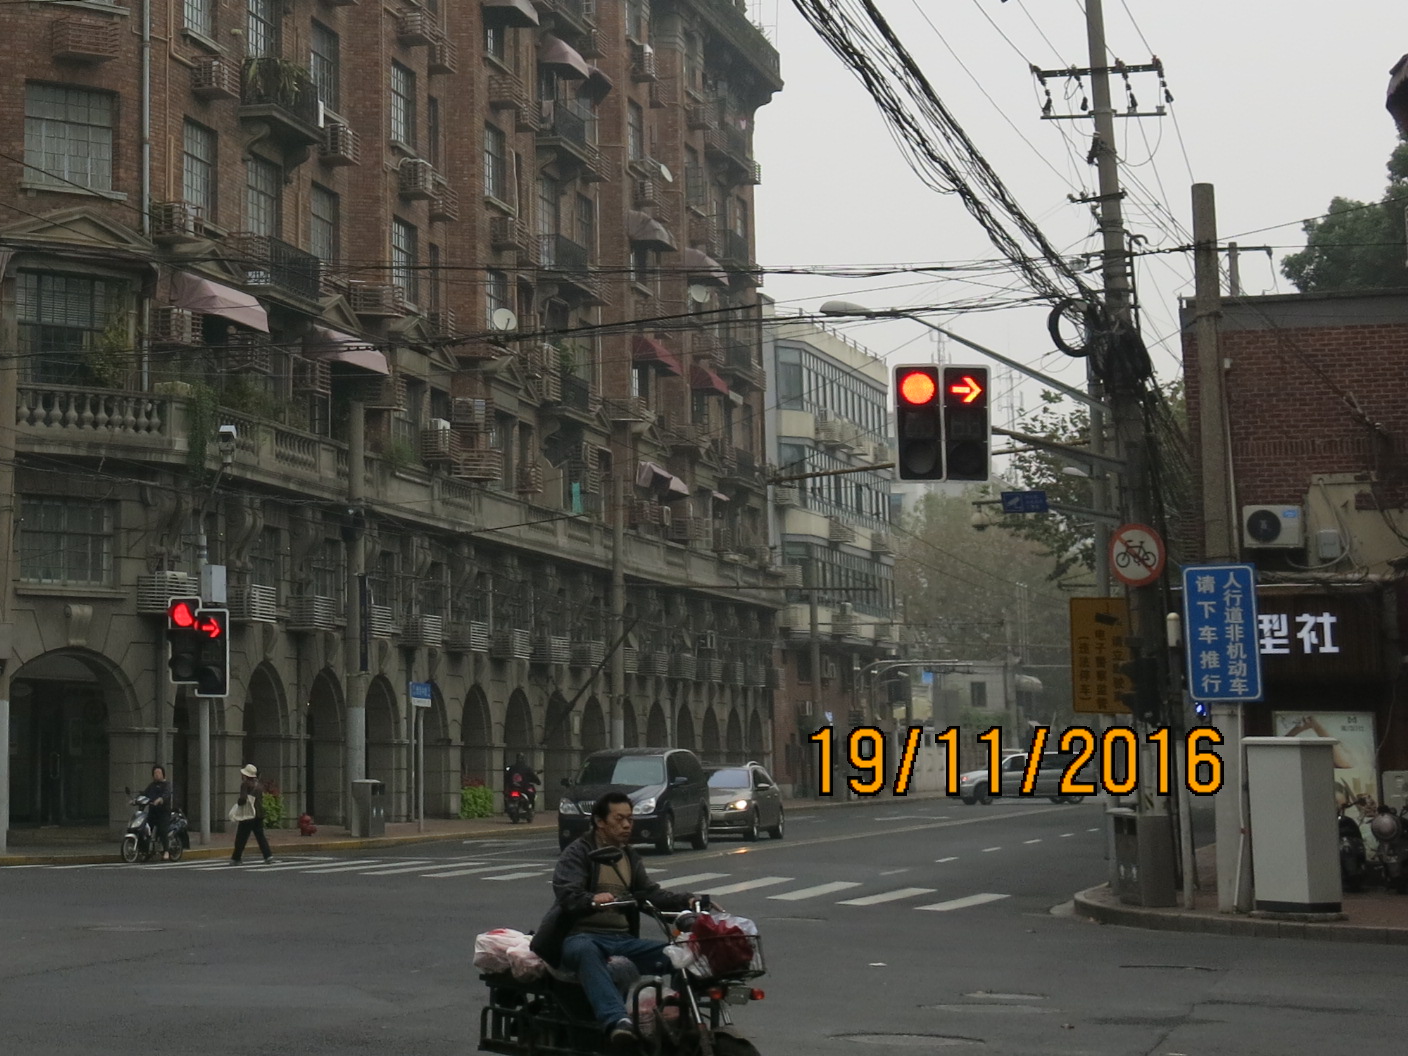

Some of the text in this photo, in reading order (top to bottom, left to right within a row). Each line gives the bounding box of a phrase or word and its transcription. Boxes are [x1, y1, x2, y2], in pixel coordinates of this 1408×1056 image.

[1195, 575, 1222, 694] 请下车推行
[1222, 571, 1249, 696] 人行道非机动车
